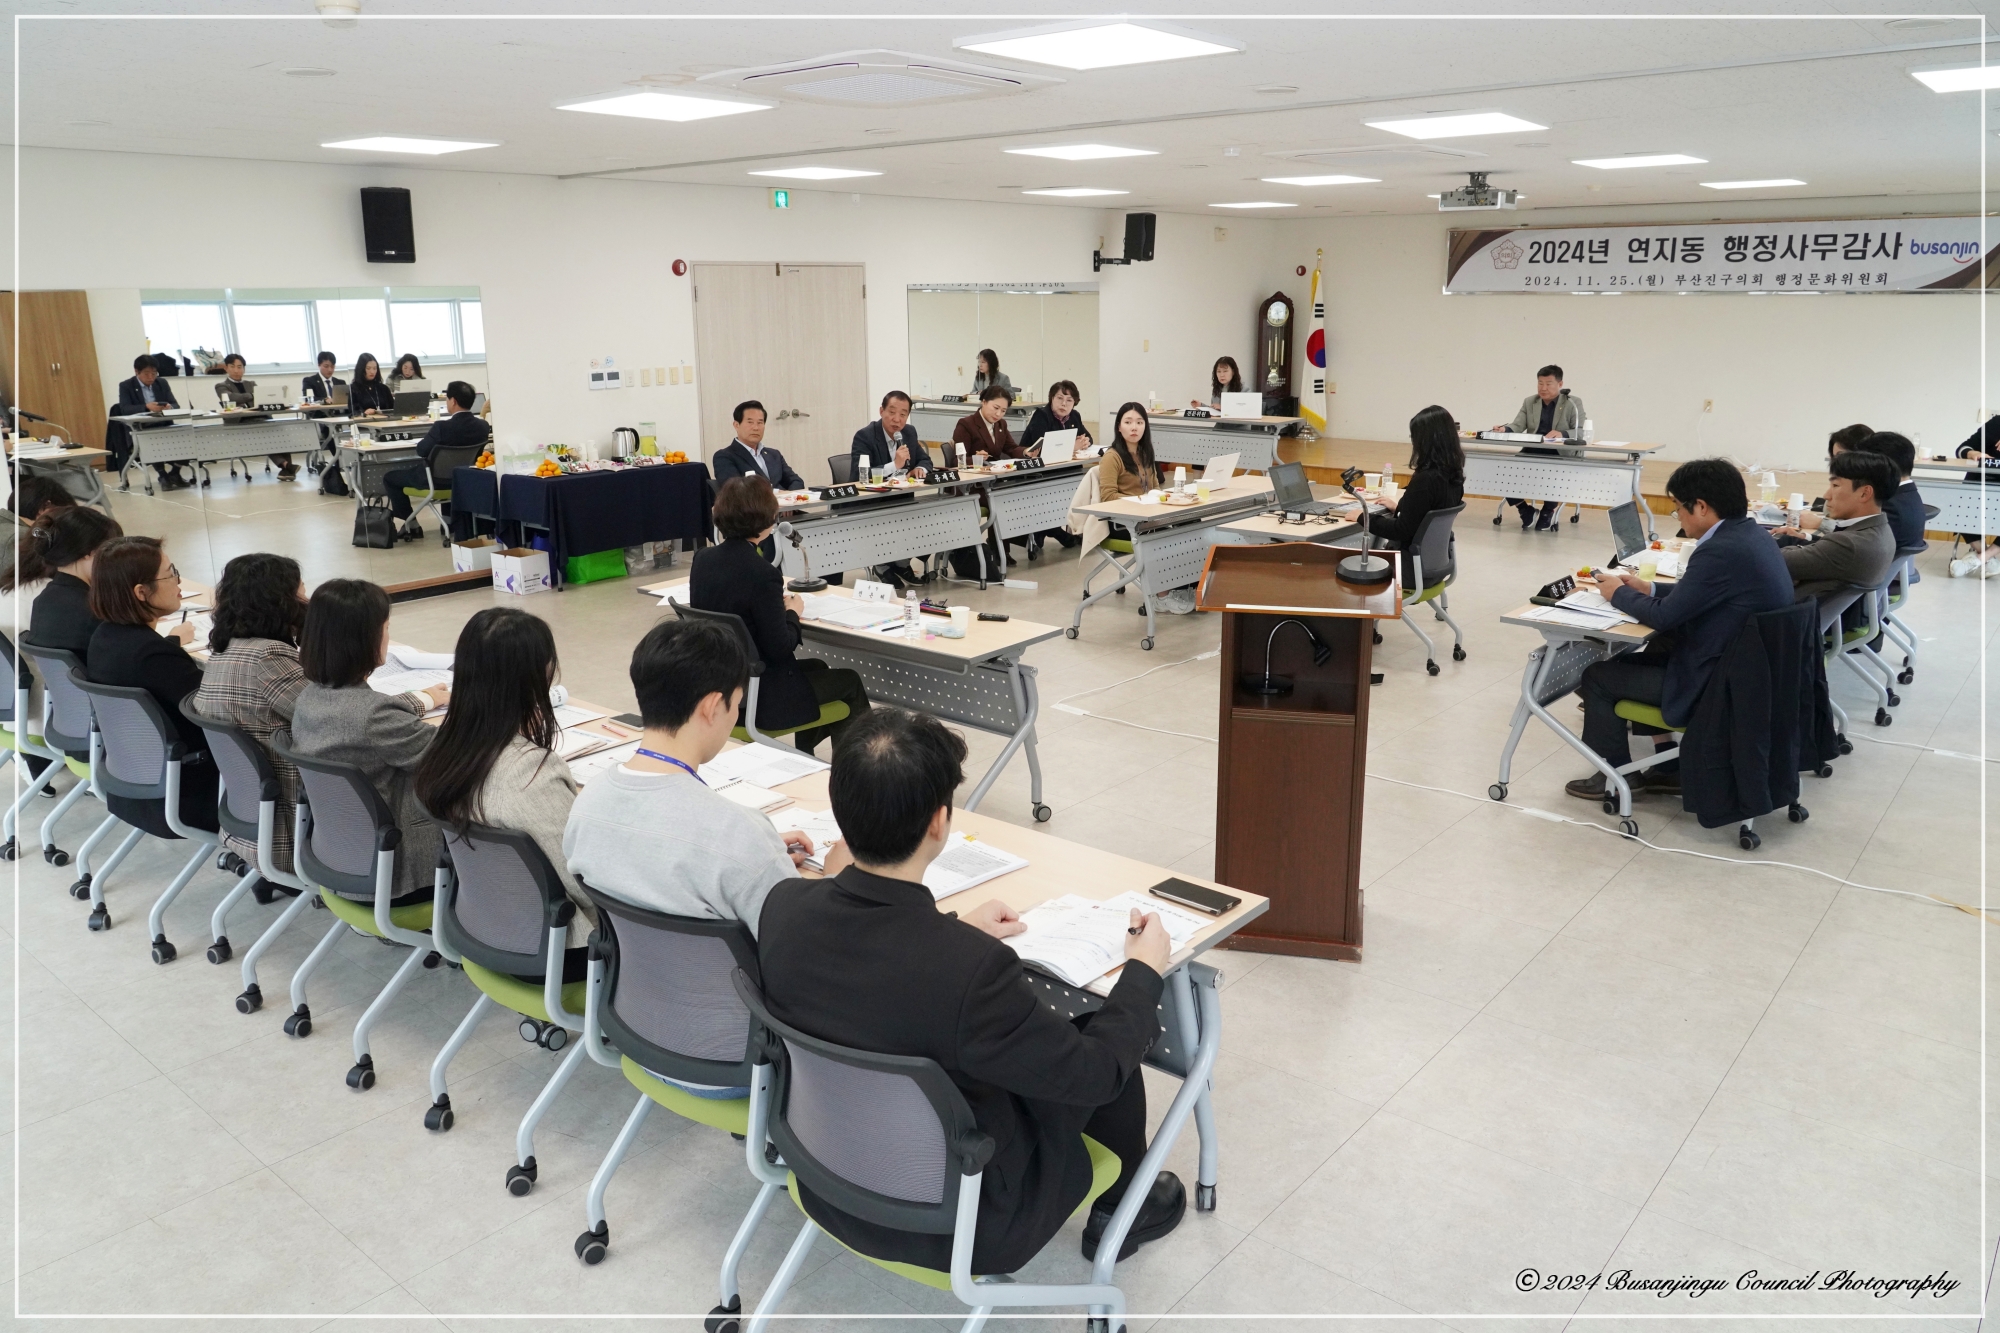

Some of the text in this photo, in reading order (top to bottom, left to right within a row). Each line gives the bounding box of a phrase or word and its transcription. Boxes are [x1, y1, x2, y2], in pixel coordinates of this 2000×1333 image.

[1528, 232, 1903, 264] 2024년 연지동 행정사무감사
[1910, 239, 1979, 258] busanjin
[1524, 272, 1888, 287] 2024. 11. 25.(월) 부산진구의회 행정문화위원회
